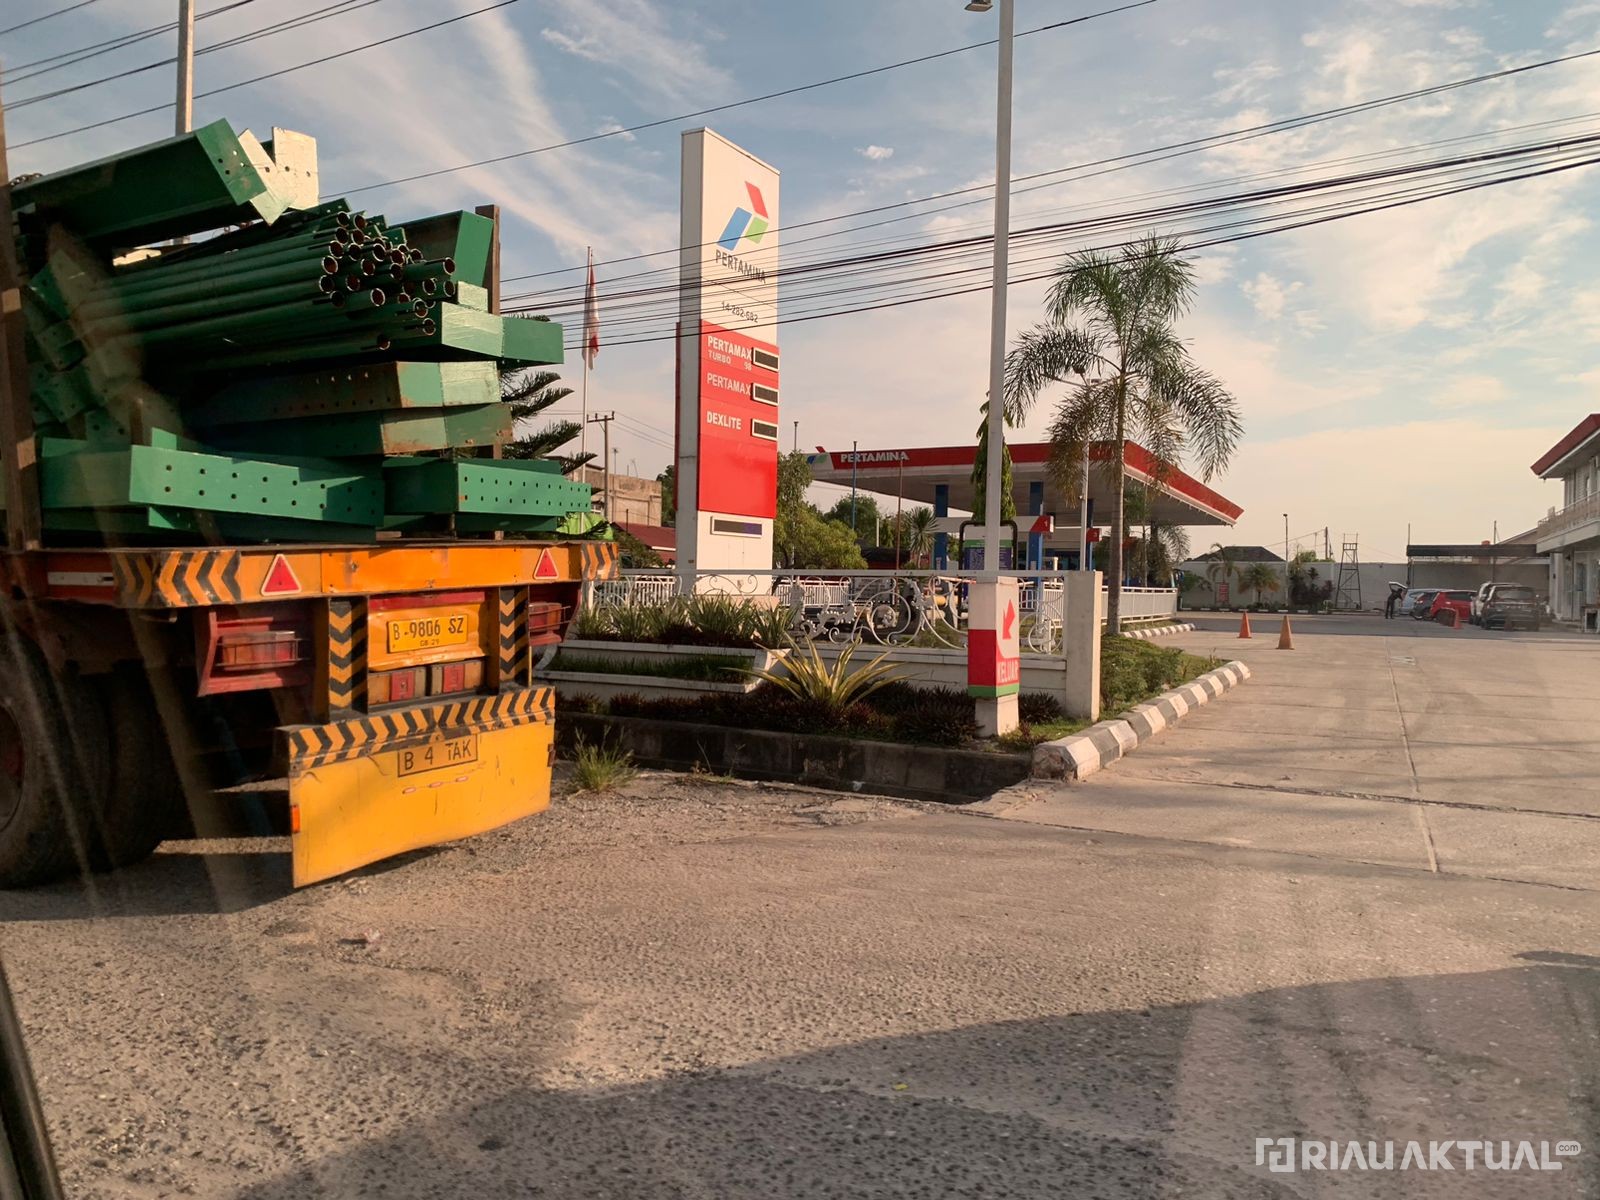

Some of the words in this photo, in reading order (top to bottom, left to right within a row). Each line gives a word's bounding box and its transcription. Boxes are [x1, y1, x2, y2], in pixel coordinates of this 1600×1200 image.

[715, 249, 767, 284] PERTAMINA
[707, 335, 752, 361] PERTAMAX
[708, 350, 732, 364] TURBO
[706, 372, 751, 396] PERTAMAX
[706, 410, 742, 430] DEXLITE
[840, 451, 909, 463] PERTAMINA
[393, 623, 400, 640] B
[448, 617, 464, 634] SZ
[404, 751, 414, 771] B
[424, 746, 434, 765] 4
[445, 739, 471, 761] TAK
